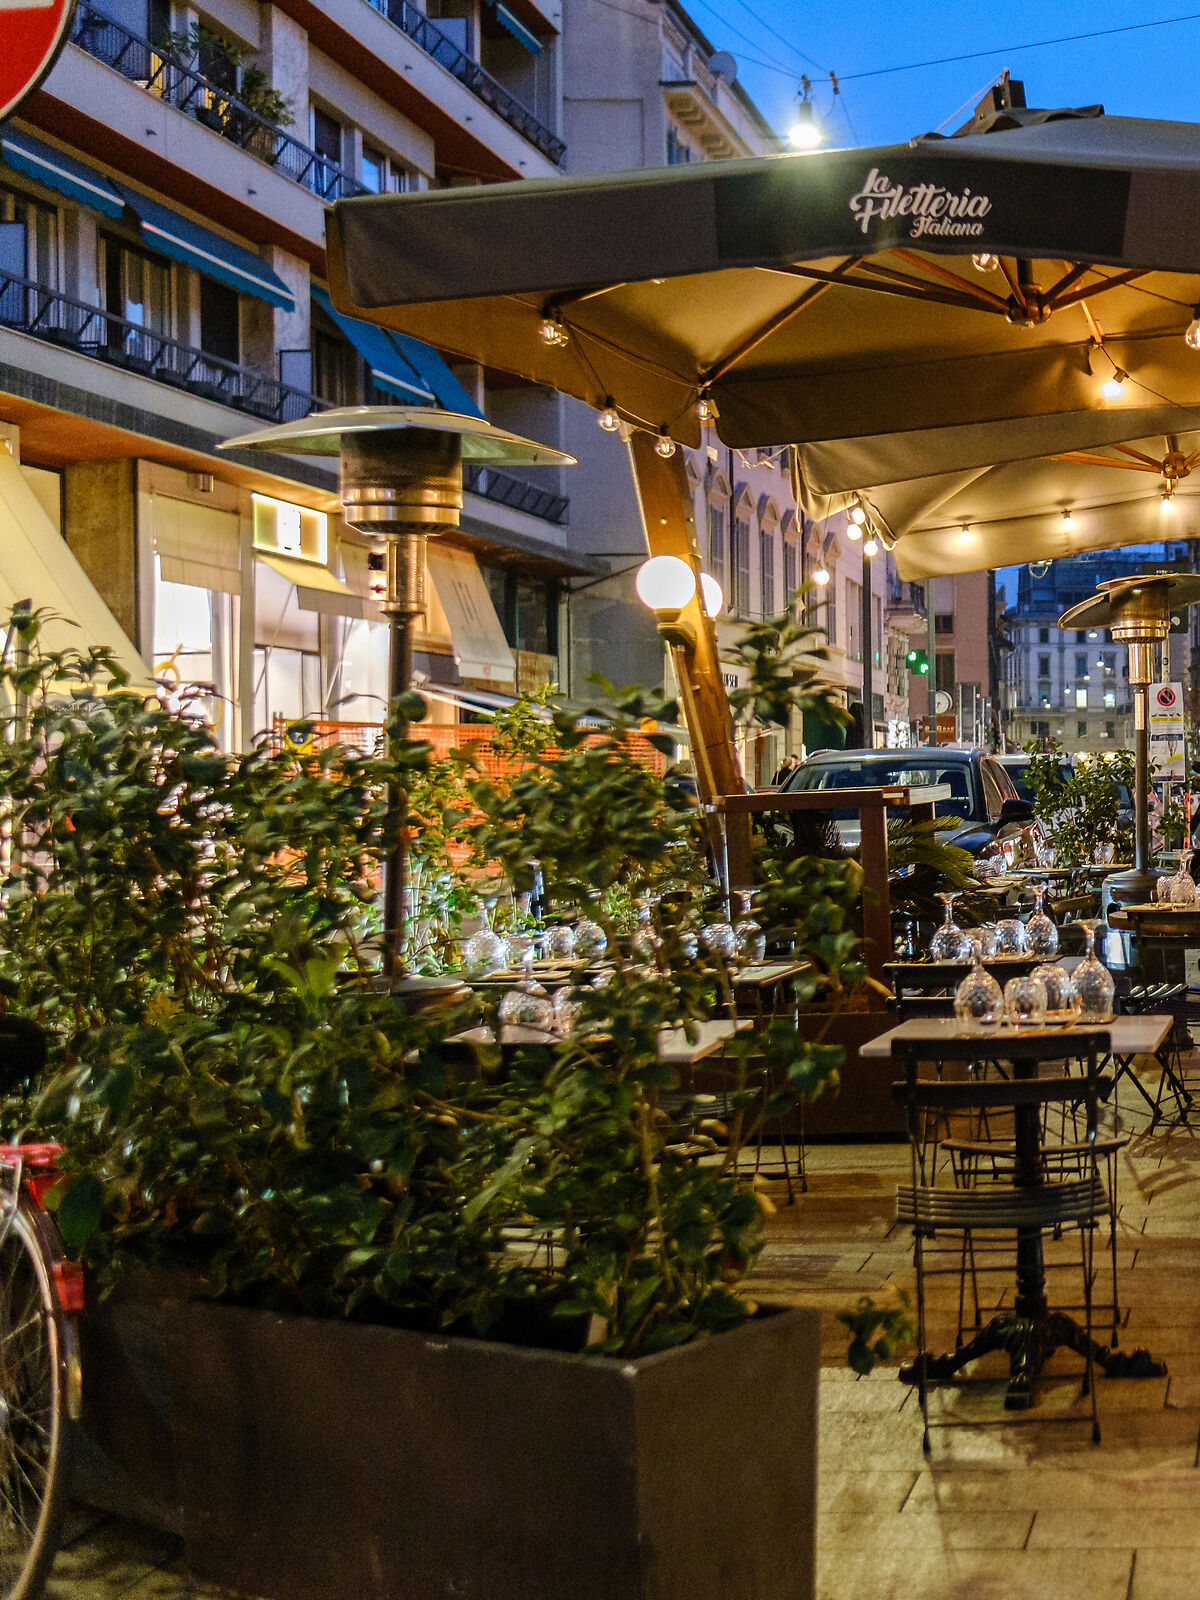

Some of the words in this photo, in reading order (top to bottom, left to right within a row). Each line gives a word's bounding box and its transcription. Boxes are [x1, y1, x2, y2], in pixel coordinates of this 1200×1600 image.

[862, 168, 891, 195] La
[850, 183, 993, 234] Filetteria
[910, 216, 985, 238] Italiana
